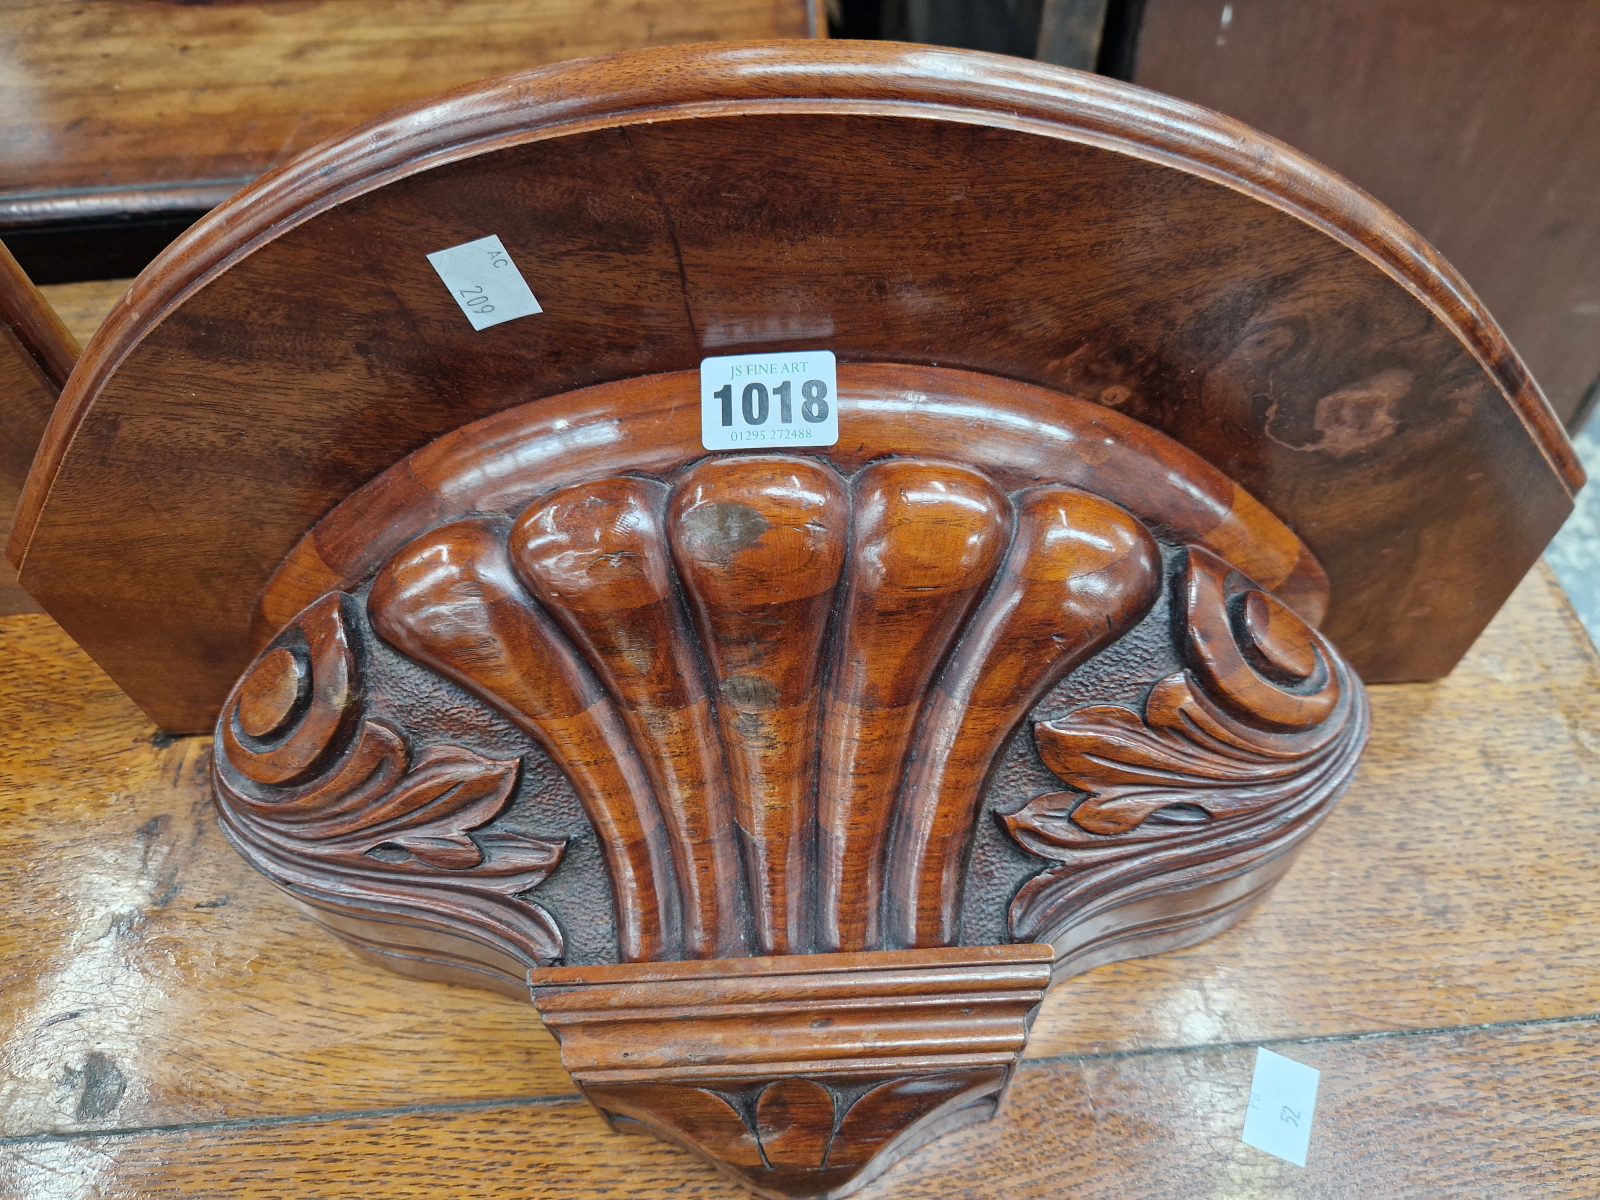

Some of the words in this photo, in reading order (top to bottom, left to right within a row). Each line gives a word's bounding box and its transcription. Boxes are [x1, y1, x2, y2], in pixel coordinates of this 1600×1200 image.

[486, 250, 508, 269] AC
[459, 285, 495, 314] 209
[730, 365, 743, 380] JS
[746, 363, 778, 376] FINE
[780, 361, 809, 375] ART
[713, 379, 830, 427] 1018
[730, 430, 766, 442] 01295
[770, 428, 812, 440] 272488
[1280, 1104, 1301, 1128] 52
